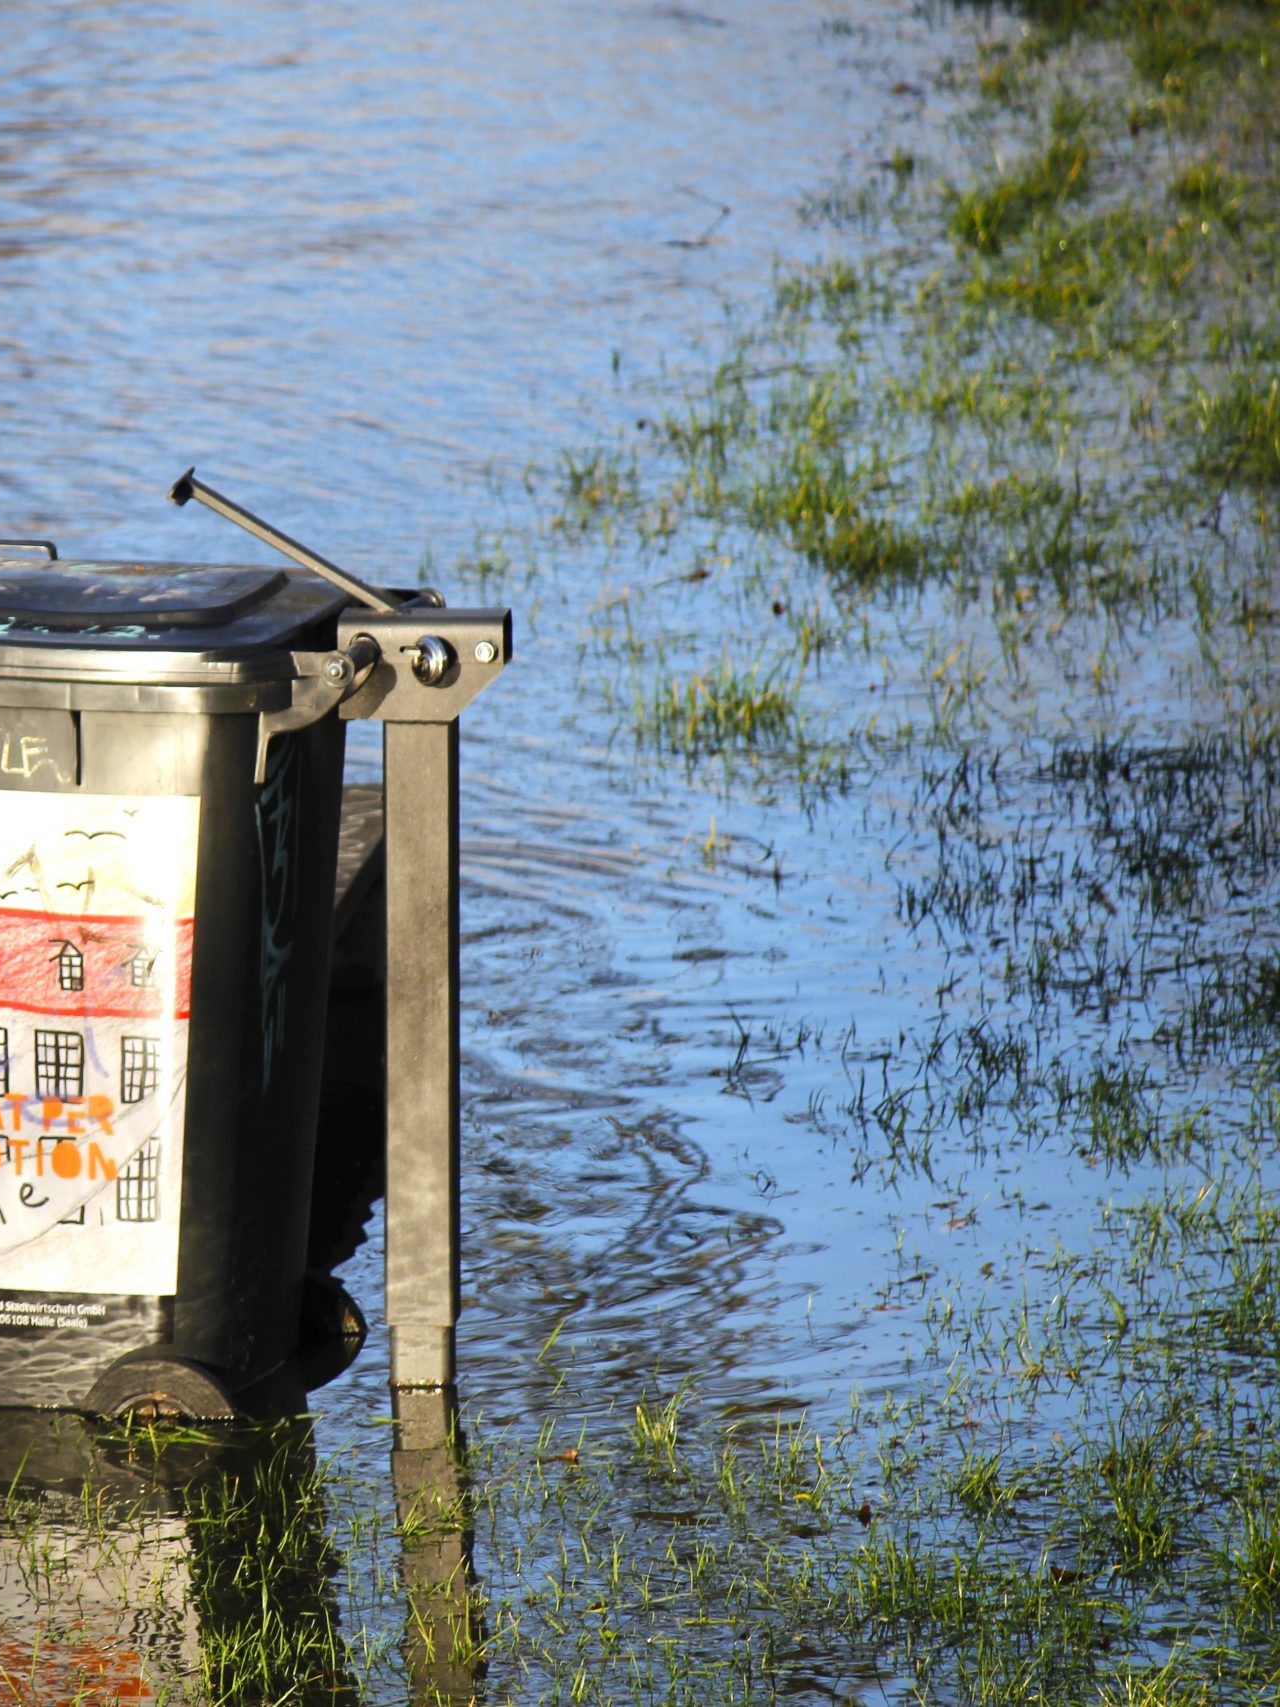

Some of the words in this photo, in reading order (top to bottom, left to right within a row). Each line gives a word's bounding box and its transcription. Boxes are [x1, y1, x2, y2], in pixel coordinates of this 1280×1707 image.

[43, 1094, 114, 1135] PER
[5, 1301, 76, 1315] Stadtwirtschaft
[77, 1304, 106, 1316] GmbH
[31, 1315, 55, 1327] Halle
[57, 1316, 88, 1329] (Saale)
